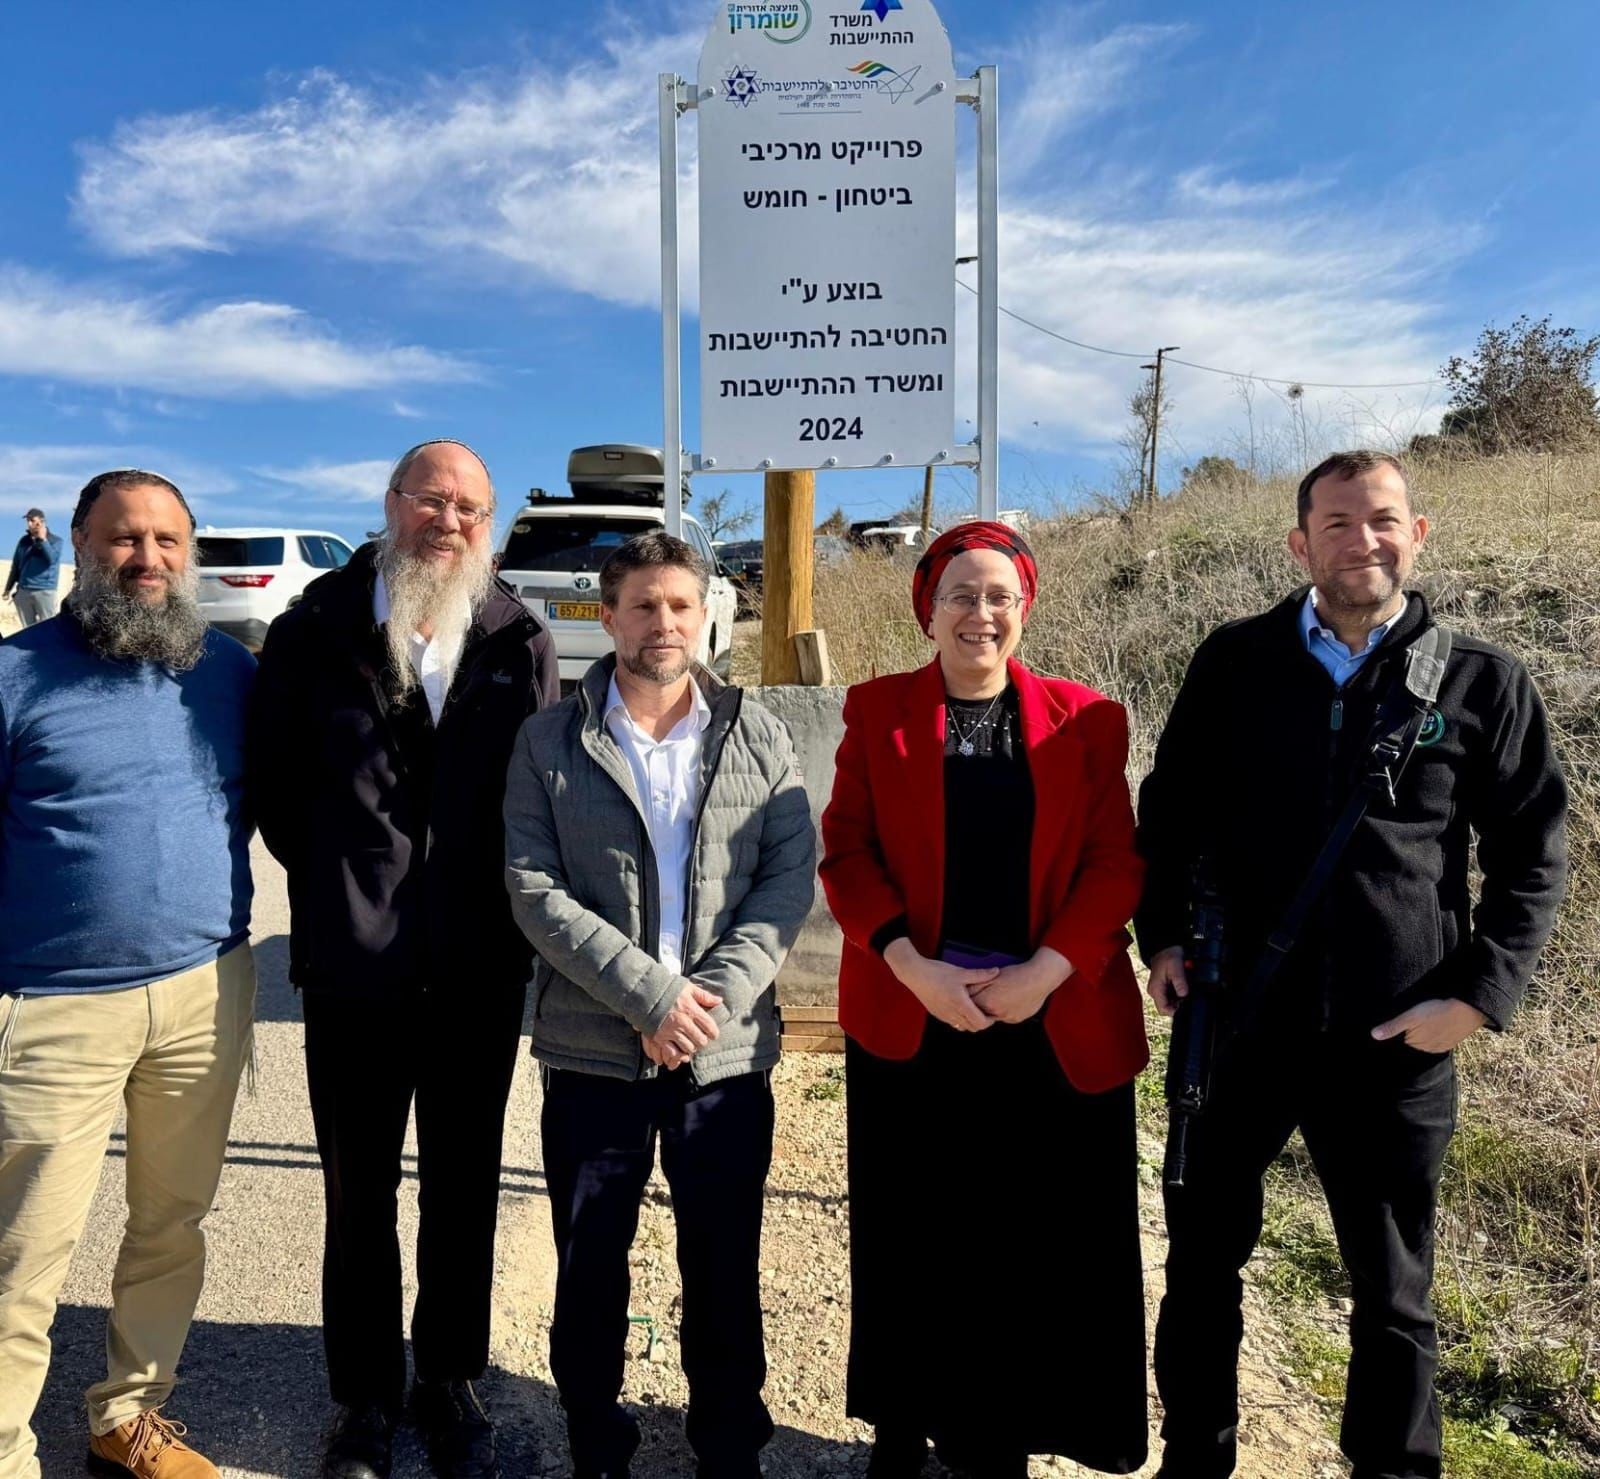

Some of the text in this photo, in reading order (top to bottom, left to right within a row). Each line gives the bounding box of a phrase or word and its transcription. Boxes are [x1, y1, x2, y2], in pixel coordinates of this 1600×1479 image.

[736, 4, 799, 13] מועצה אזורית
[728, 13, 799, 34] שומרון
[829, 14, 872, 28] משרד
[829, 31, 914, 46] ההתיישבות
[761, 79, 825, 92] להתיישבות
[741, 139, 923, 165] פרוייקט מרכיבי
[743, 189, 808, 209] חומש
[835, 187, 913, 213] ביטחון
[781, 278, 883, 304] בוצע ע"י
[708, 324, 948, 351] החטיבה להתיישבות
[719, 373, 944, 398] ומשרד ההתיישבות
[799, 416, 864, 441] 2024
